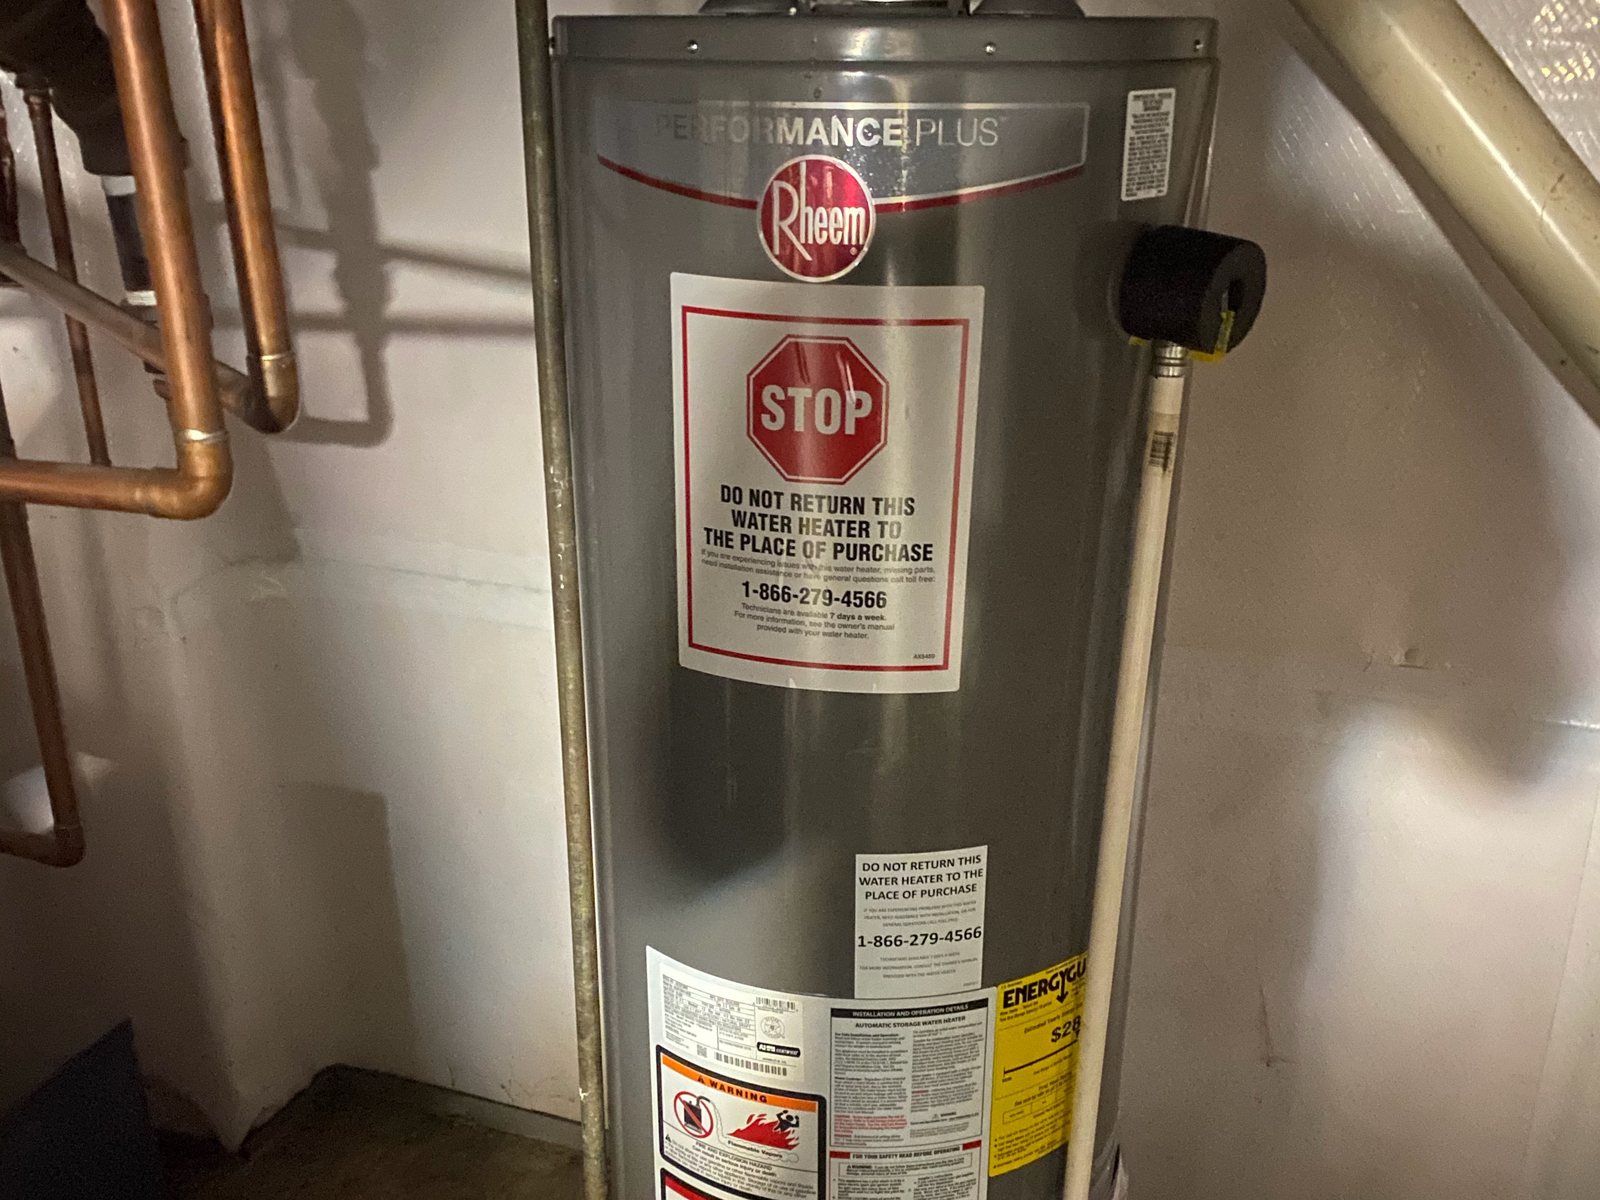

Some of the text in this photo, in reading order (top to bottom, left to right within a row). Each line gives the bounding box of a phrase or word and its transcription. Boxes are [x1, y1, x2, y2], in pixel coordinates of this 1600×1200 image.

[915, 117, 999, 147] PLUS
[772, 160, 866, 261] Rheem
[761, 384, 873, 435] STOP
[720, 484, 915, 516] DO NOT RETURN THIS
[731, 509, 902, 539] WATER HEATER TO
[704, 527, 933, 562] THE PLACE OF PURCHASE
[732, 555, 776, 568] experiencing
[852, 575, 888, 583] questions
[742, 580, 887, 609] 1-866-279-4566
[734, 610, 746, 618] For
[747, 613, 764, 621] more
[766, 615, 807, 627] information,
[824, 621, 836, 629] the
[837, 622, 865, 630] owner's
[742, 602, 781, 615] Technicians
[796, 609, 828, 619] available
[829, 612, 835, 620] 7
[836, 613, 856, 621] days
[757, 623, 869, 639] provided with your water heater.
[862, 855, 981, 872] DO NOT RETURN THIS
[859, 868, 983, 886] WATER HEATER TO THE
[865, 883, 977, 900] PLACE OF PURCHASE
[858, 926, 982, 948] 1-866-279-4566
[1003, 957, 1086, 1008] ENERGYGU
[911, 1008, 945, 1016] OPERATION
[946, 1004, 969, 1013] DETAILS
[892, 1020, 921, 1028] STORAGE
[922, 1018, 942, 1026] WATER
[943, 1016, 966, 1024] HEATER
[1051, 1015, 1081, 1043] $28
[710, 1080, 768, 1104] WARNING
[719, 1149, 748, 1165] EXPLOSION
[749, 1159, 773, 1171] HAZARD
[727, 1139, 783, 1160] Flammable Vapors
[913, 1150, 932, 1158] BEFORE
[933, 1146, 960, 1156] OPERATING
